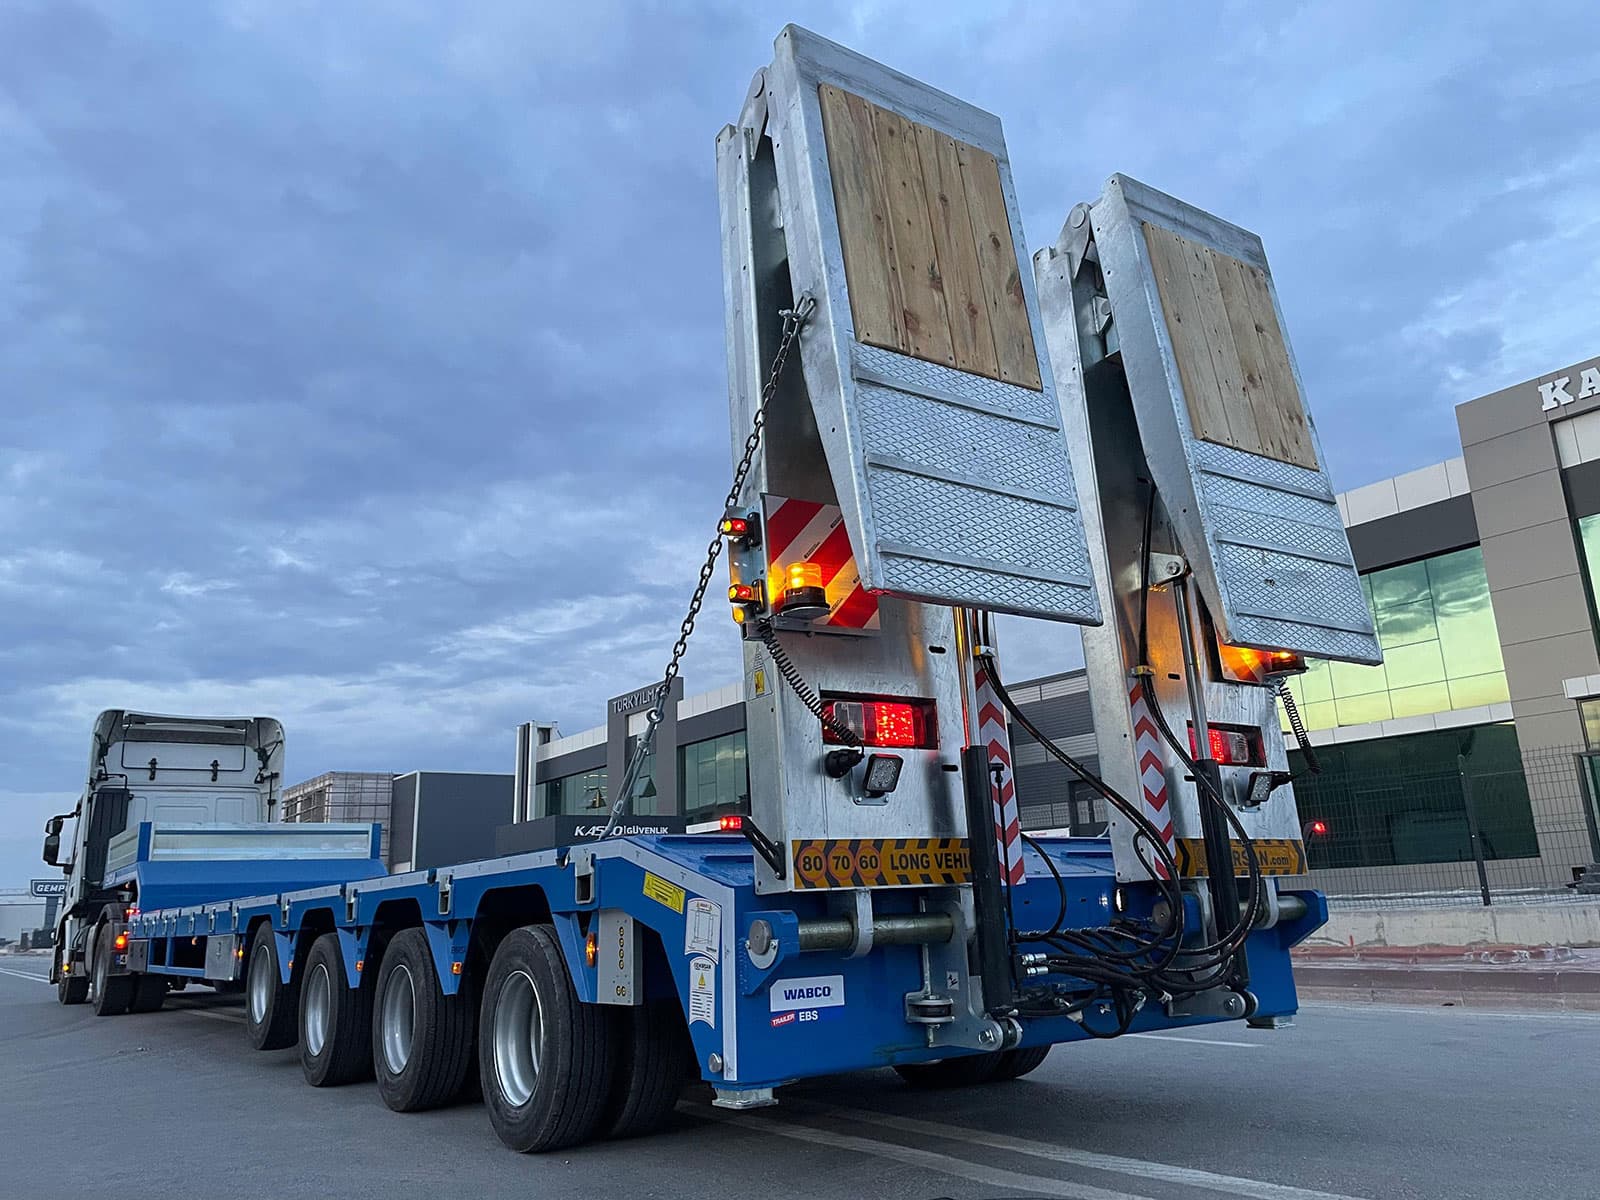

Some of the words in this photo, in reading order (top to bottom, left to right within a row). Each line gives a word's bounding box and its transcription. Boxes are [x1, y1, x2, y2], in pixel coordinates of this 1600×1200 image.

[574, 825, 623, 836] KASO
[803, 855, 823, 871] 80
[833, 855, 850, 870] 70
[859, 855, 878, 869] 60
[890, 853, 930, 870] LONG
[934, 852, 968, 869] VEHI
[784, 986, 831, 1000] WABCO
[799, 1010, 818, 1021] EBS
